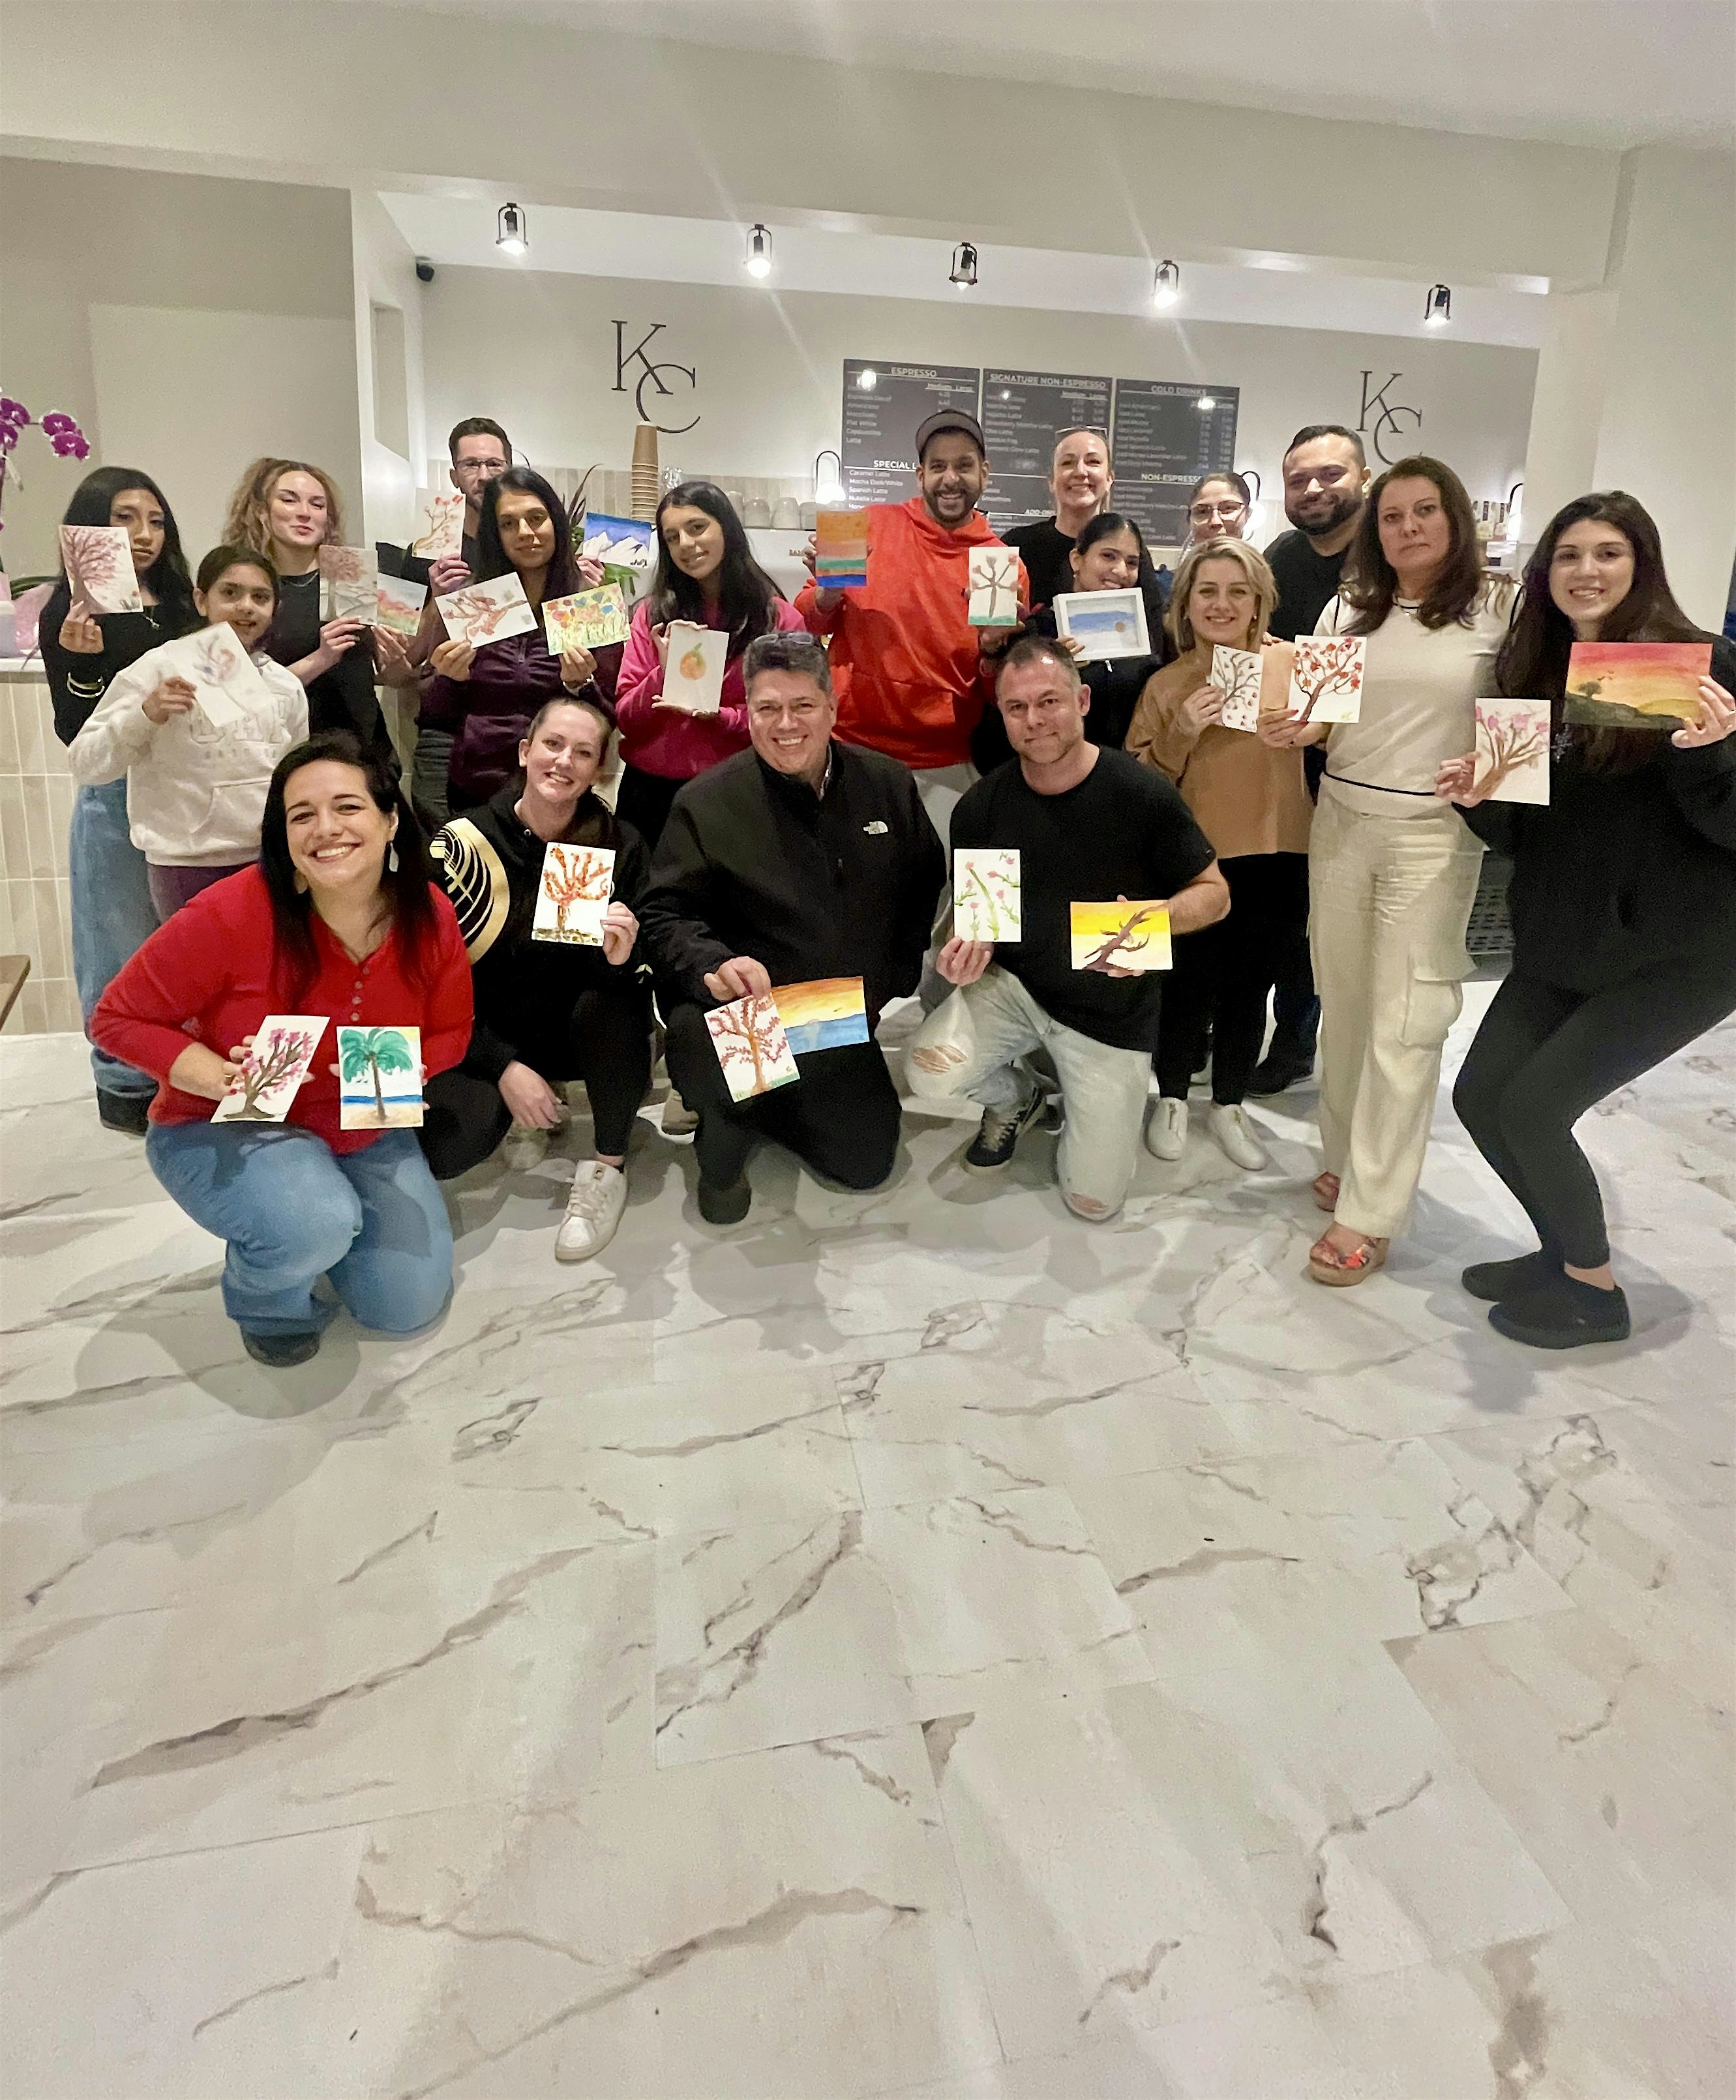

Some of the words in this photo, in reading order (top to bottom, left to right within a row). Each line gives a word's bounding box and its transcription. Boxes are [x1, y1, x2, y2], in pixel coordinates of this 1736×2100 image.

[891, 367, 937, 378] ESPRESSO
[990, 373, 1039, 383] SIGNATURE
[1040, 377, 1107, 389] NON-ESPRESSO
[1150, 385, 1175, 394] COLD
[1176, 387, 1207, 396] DRINKS
[873, 460, 910, 470] SPECIAL
